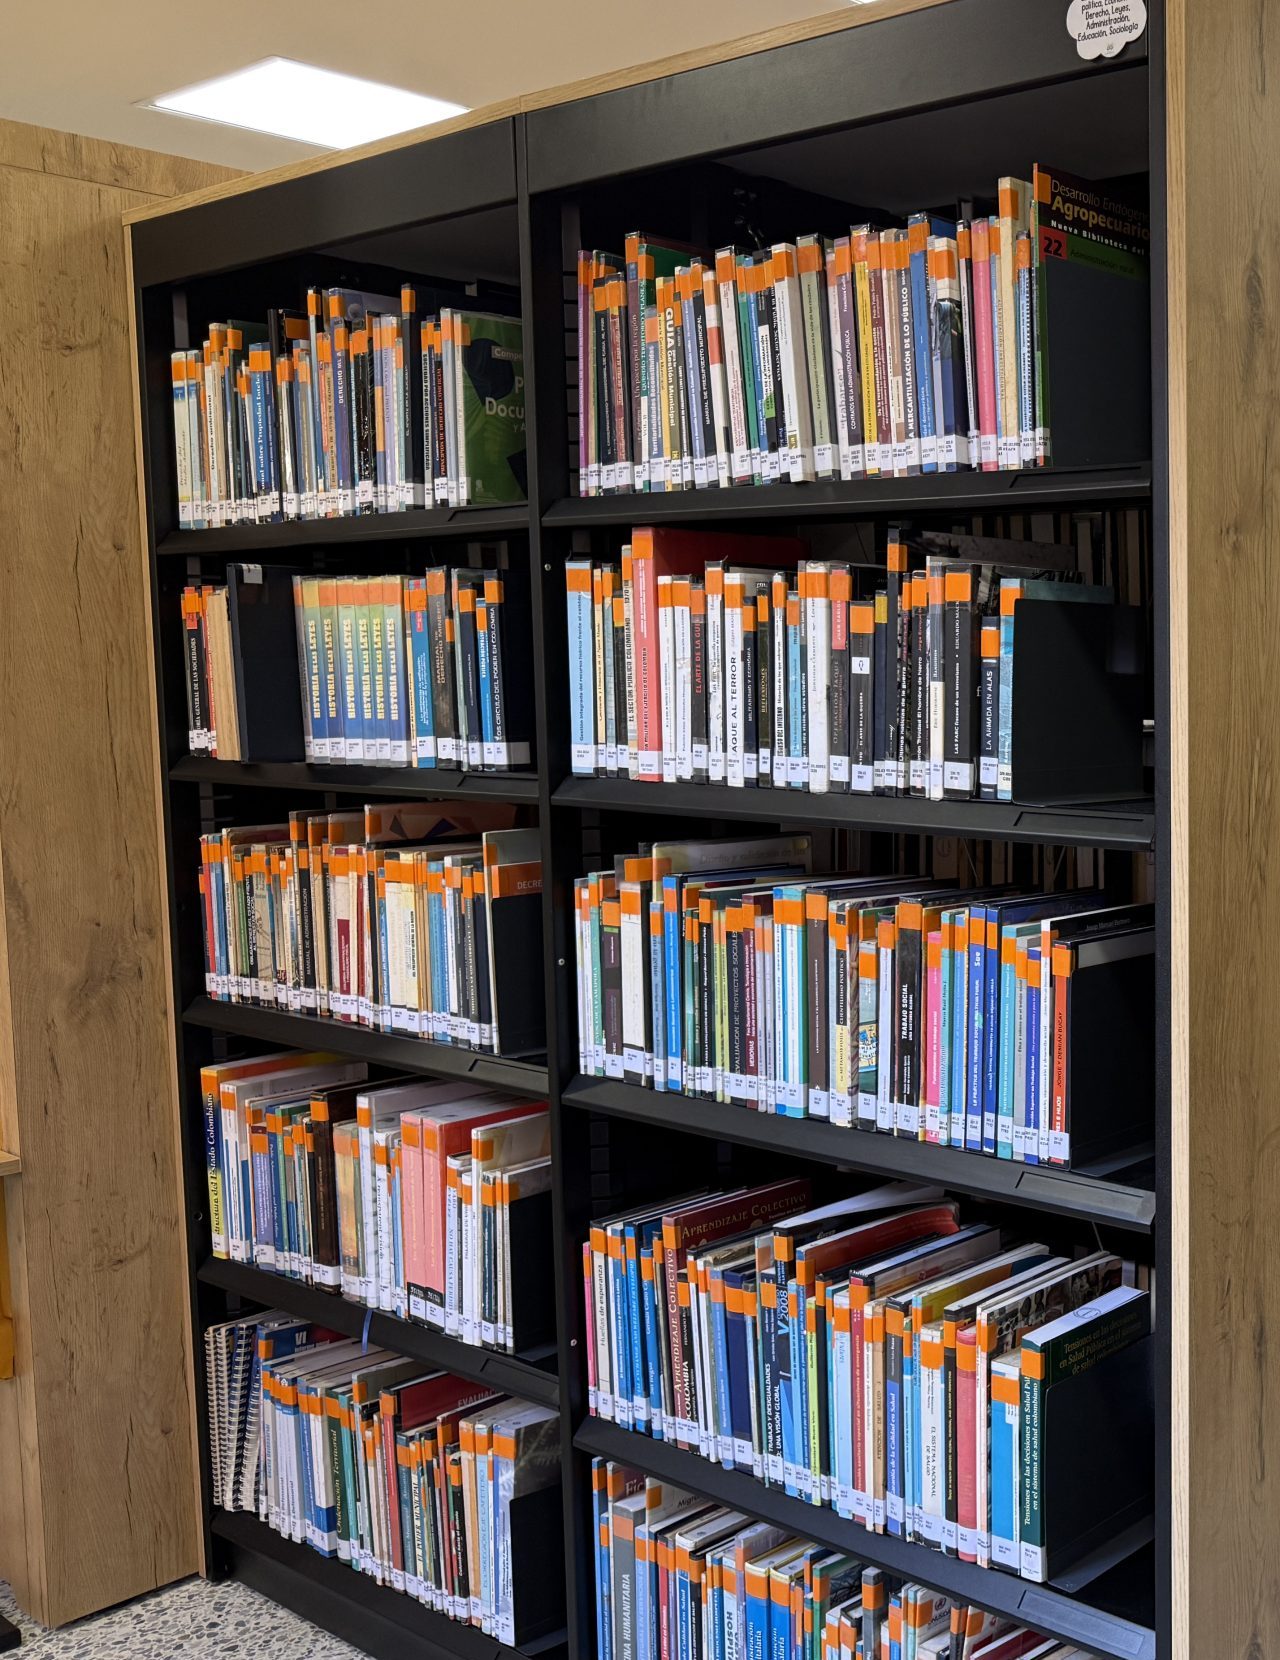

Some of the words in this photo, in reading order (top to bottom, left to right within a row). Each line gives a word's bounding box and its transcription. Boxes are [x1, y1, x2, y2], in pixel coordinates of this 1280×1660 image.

[1051, 180, 1100, 207] Desarrollo
[1051, 195, 1150, 240] Agropecuario
[1043, 236, 1063, 257] 22
[1051, 219, 1078, 234] Nueva
[1082, 230, 1128, 250] Biblioteca
[903, 325, 910, 336] LO
[904, 338, 910, 349] DE
[904, 351, 914, 430] MERCANTILIZACIÓN
[308, 620, 316, 649] LEYES
[324, 619, 332, 647] LEYES
[343, 619, 352, 648] LEYES
[359, 619, 368, 648] LEYES
[373, 618, 382, 648] LEYES
[387, 618, 395, 648] LEYES
[312, 675, 321, 718] HISTORIA
[327, 674, 336, 717] HISTORIA
[346, 675, 356, 718] HISTORIA
[362, 675, 371, 719] HISTORIA
[376, 675, 384, 719] HISTORIA
[389, 675, 398, 720] HISTORIA
[986, 694, 992, 704] EN
[986, 739, 992, 750] LA
[681, 1210, 748, 1240] APRENDIZAJE
[667, 1249, 677, 1313] COLECTIVO
[599, 1306, 604, 1316] de
[780, 1290, 789, 1319] 2008
[671, 1318, 682, 1392] APRENDIZAJE
[891, 1414, 896, 1422] en
[1025, 1414, 1030, 1424] en
[1032, 1450, 1038, 1459] de
[1025, 1478, 1030, 1488] en
[1033, 1500, 1038, 1510] en
[621, 1573, 631, 1641] HUMANITARIA
